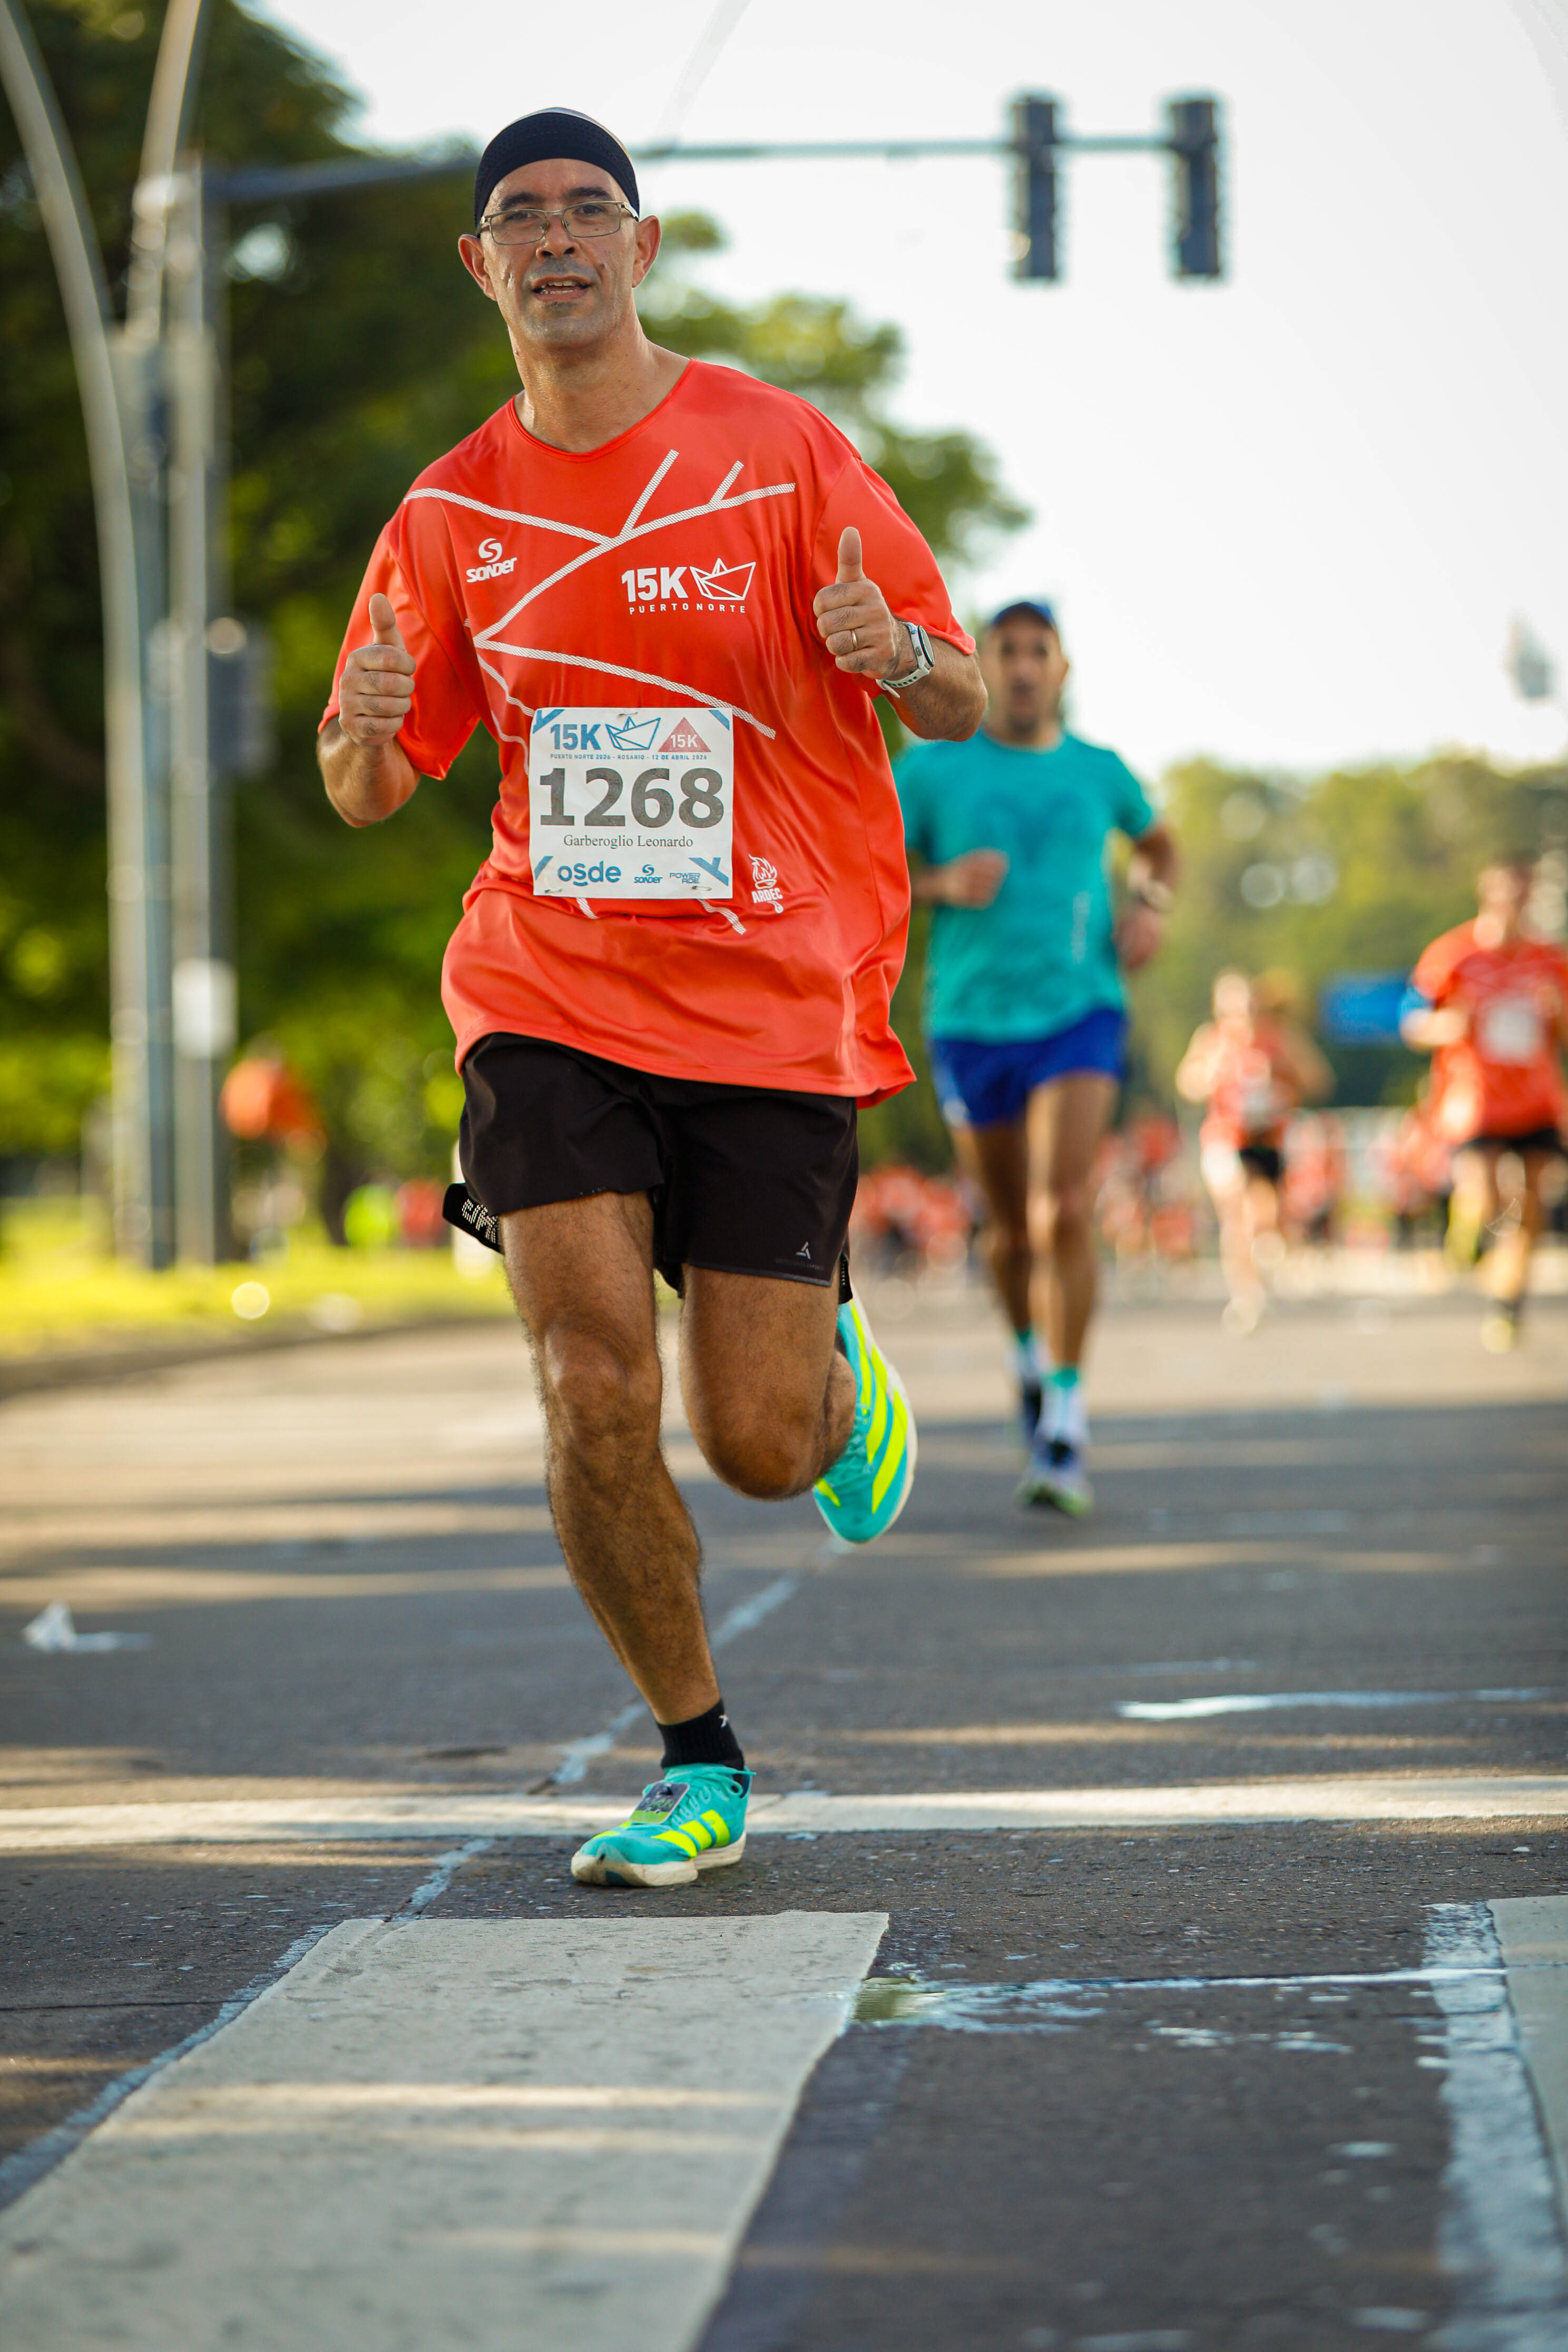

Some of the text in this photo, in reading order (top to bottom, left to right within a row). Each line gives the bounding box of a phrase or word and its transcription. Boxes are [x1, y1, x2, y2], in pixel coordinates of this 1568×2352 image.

[621, 566, 689, 603] 15K
[629, 603, 745, 615] PUERTO NORTE
[550, 723, 602, 750] 15K
[670, 734, 699, 748] 15K
[540, 767, 724, 829] 1268
[563, 834, 693, 849] Garberoglio Leonardo
[557, 860, 622, 884] osde
[751, 887, 783, 904] ARDEC
